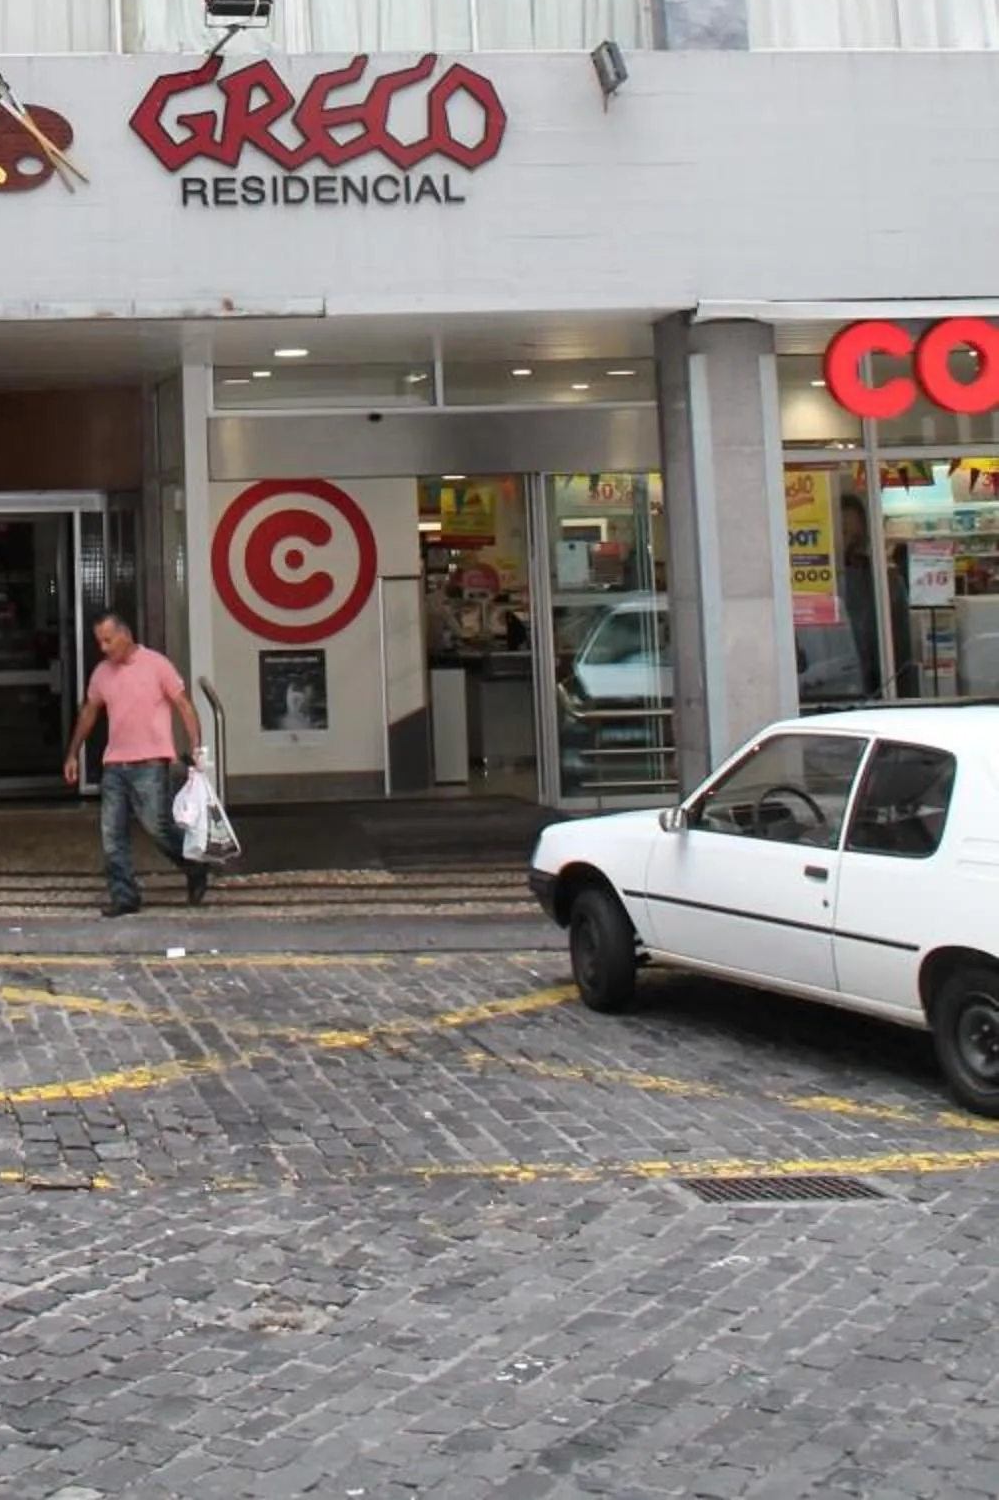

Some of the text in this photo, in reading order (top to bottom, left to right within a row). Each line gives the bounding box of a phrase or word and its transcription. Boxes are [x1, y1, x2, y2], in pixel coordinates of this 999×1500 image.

[129, 54, 507, 171] GRECO
[180, 174, 465, 208] RESIDENCIAL
[824, 316, 999, 420] CO
